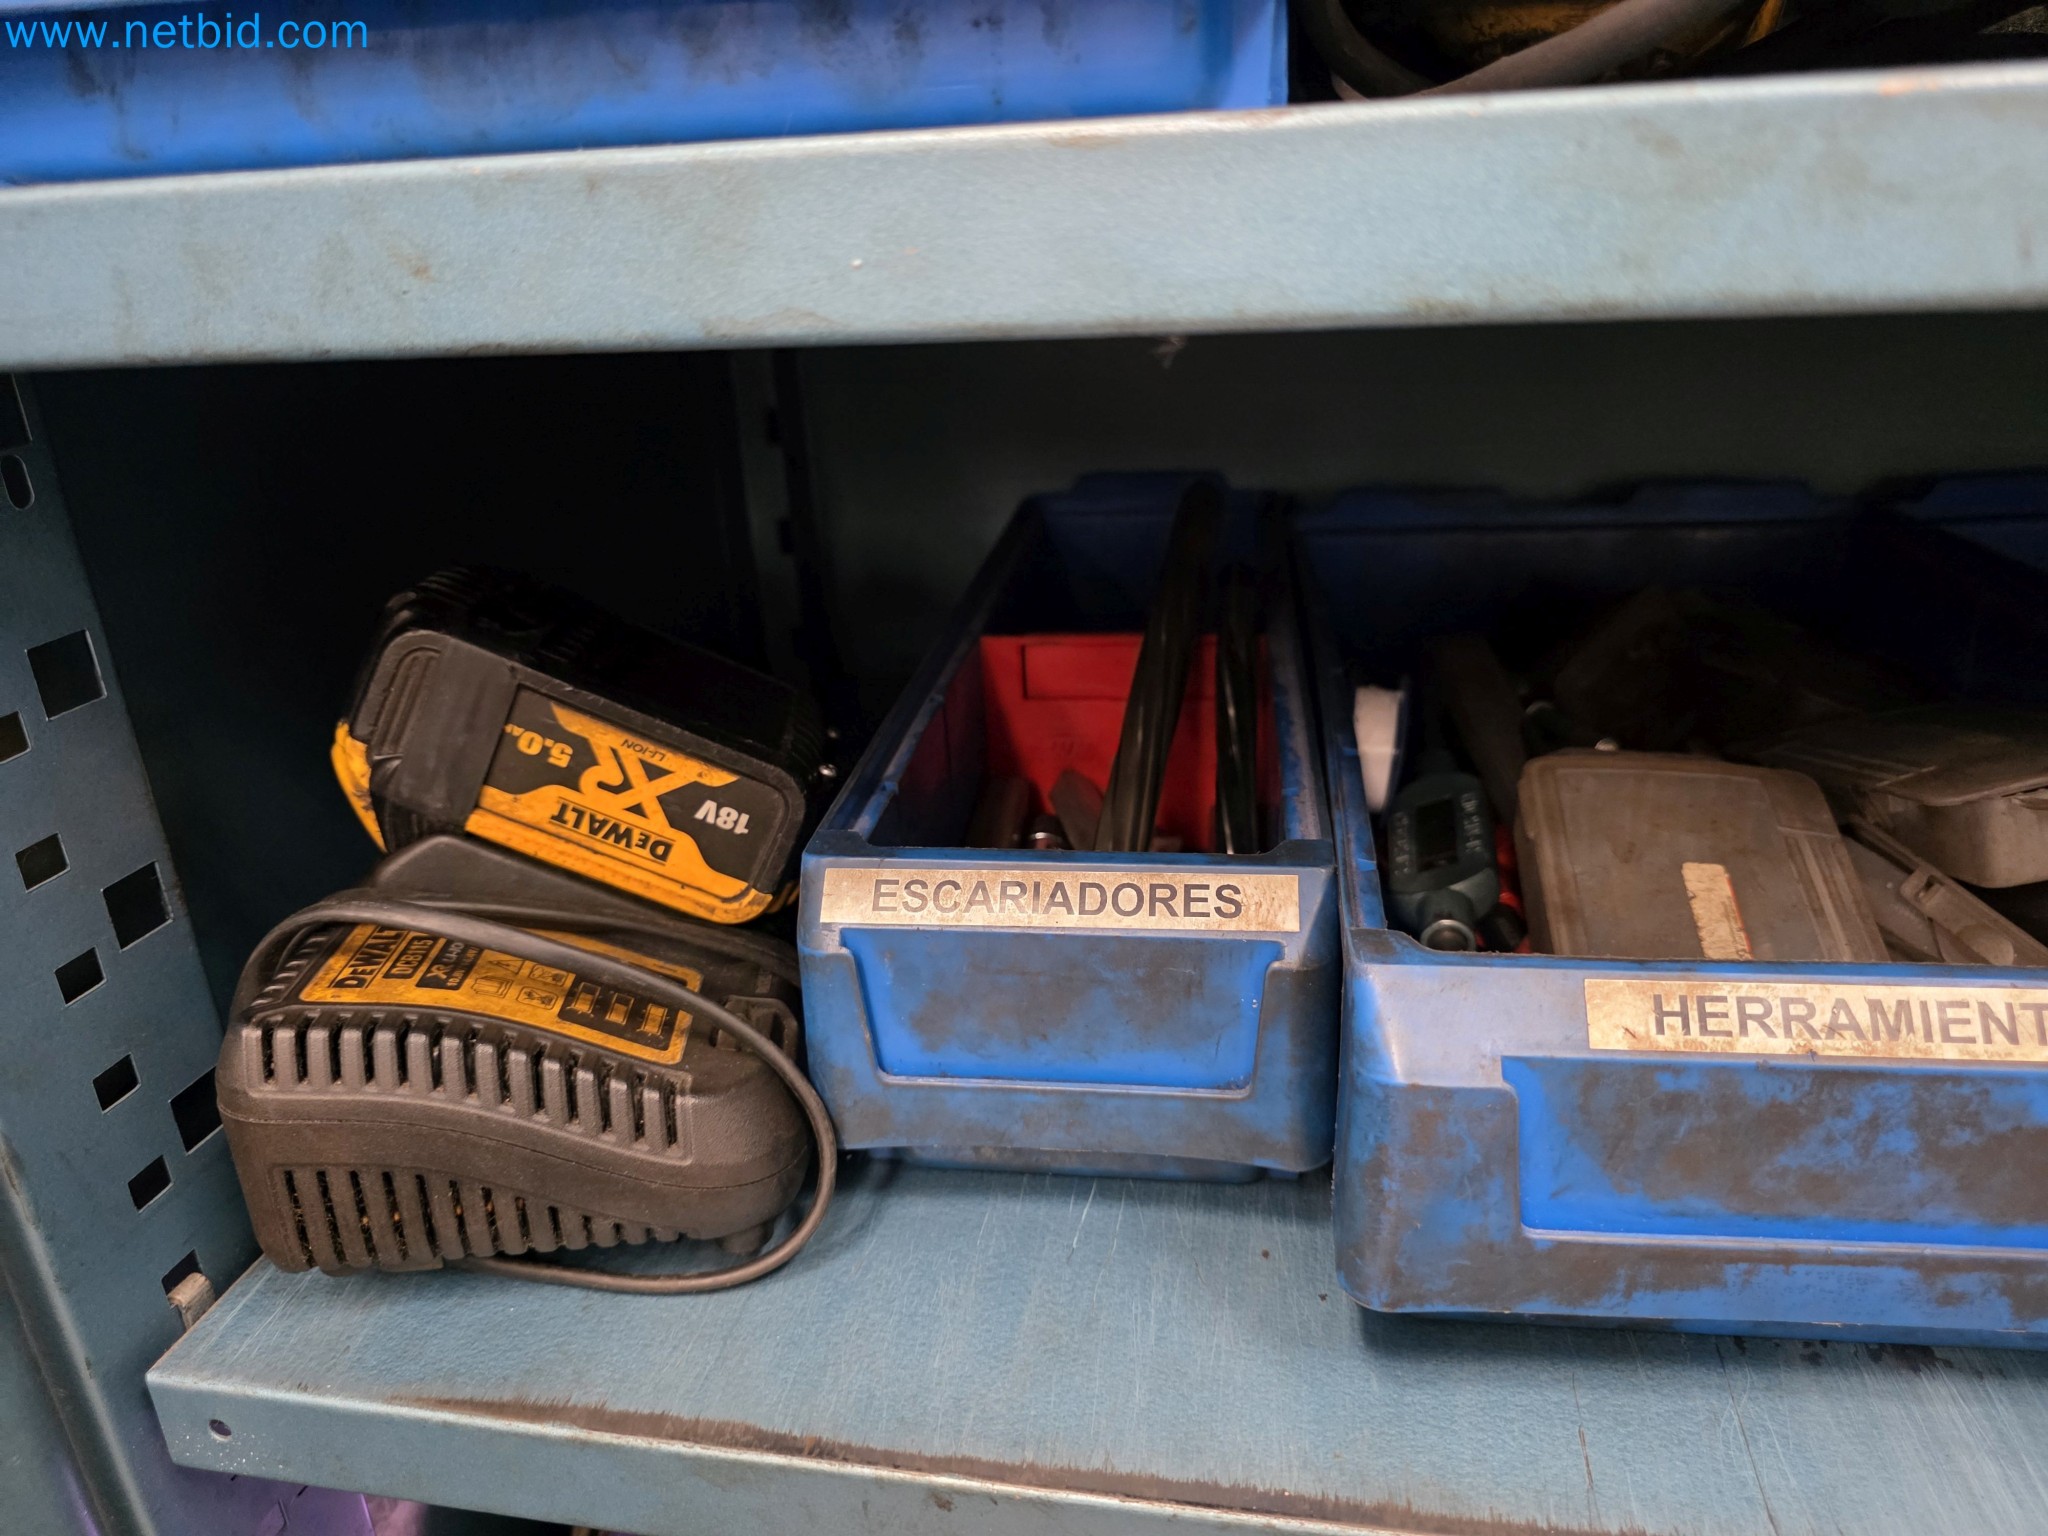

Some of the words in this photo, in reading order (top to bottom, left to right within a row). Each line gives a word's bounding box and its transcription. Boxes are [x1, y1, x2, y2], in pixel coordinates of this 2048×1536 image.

[620, 738, 667, 762] LI-ION
[694, 799, 750, 835] 18V
[871, 878, 1244, 919] ESCARIADORES
[390, 939, 434, 974] DCB115
